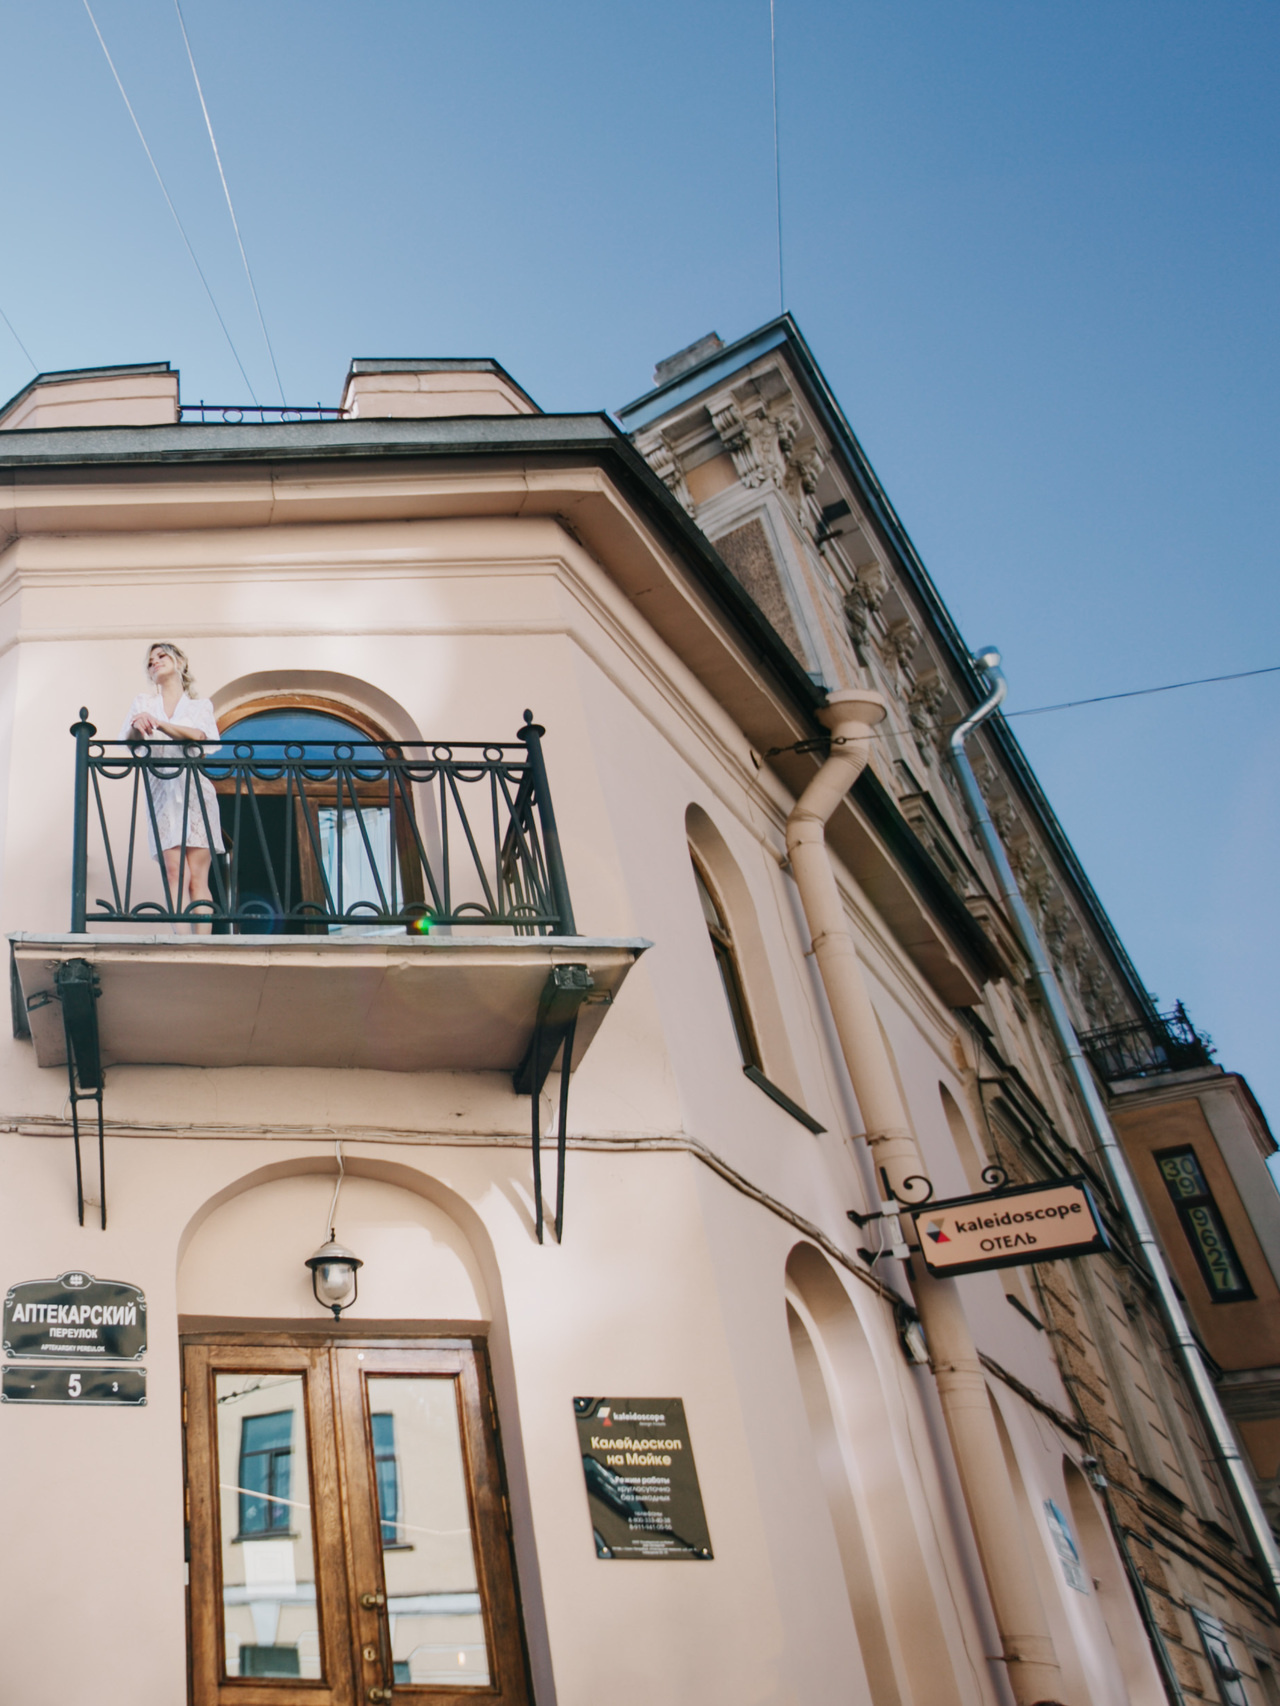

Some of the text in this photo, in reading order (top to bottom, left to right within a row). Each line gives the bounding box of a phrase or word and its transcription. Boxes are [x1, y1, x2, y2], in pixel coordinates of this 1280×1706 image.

[1163, 1156, 1196, 1178] 30
[955, 1202, 1082, 1234] kaleidoscope
[979, 1232, 1038, 1252] ОТЕЛЬ
[11, 1302, 137, 1326] АПТЕКАРСКИЙ
[49, 1327, 98, 1339] ПЕРЕУЛОК
[68, 1373, 82, 1398] 5
[112, 1382, 119, 1392] 3
[613, 1411, 665, 1422] kaleidoscope
[590, 1436, 682, 1451] Калейдоскоп
[606, 1452, 672, 1466] на Мойке
